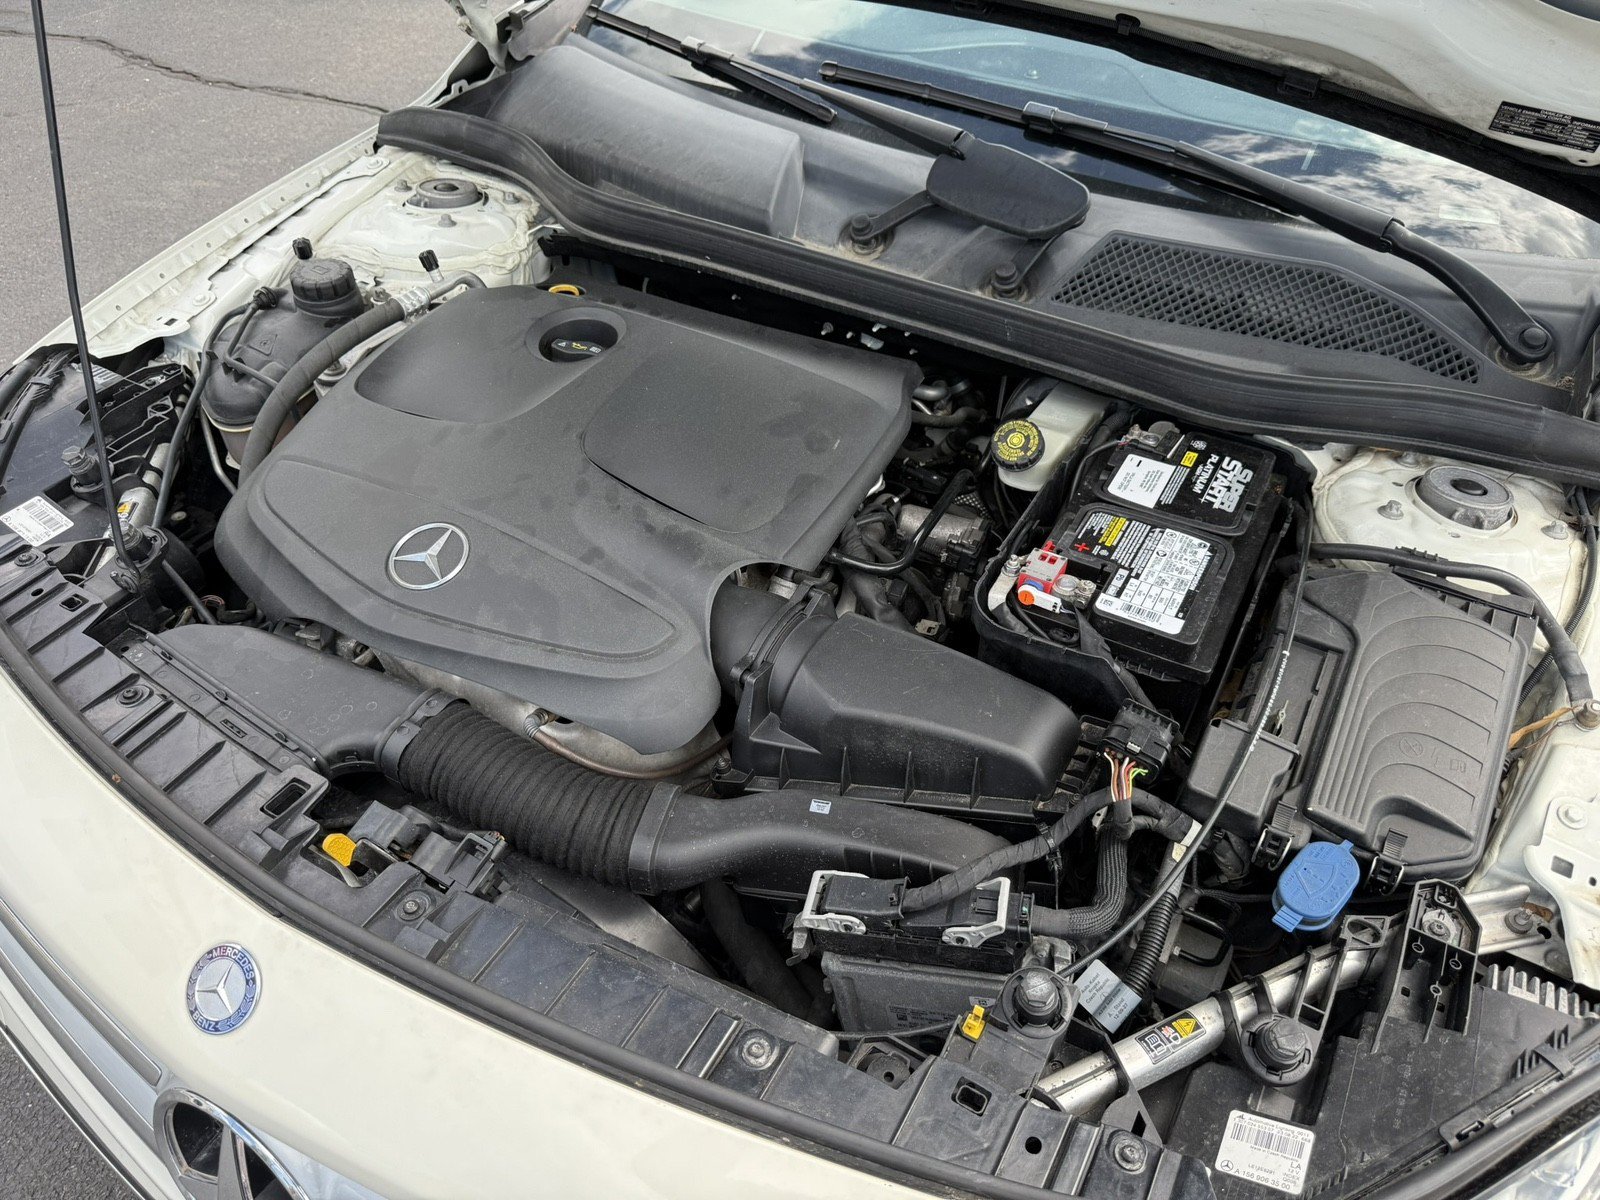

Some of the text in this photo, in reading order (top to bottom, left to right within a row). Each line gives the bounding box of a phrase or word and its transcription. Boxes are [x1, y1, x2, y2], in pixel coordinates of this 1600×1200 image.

[1501, 105, 1521, 113] VEHICLE
[1522, 110, 1547, 118] EMISSION
[1548, 115, 1571, 123] CONTROL
[1192, 453, 1219, 493] PLATINUM
[1207, 457, 1243, 510] START
[1219, 466, 1254, 512] SUPER
[212, 946, 254, 980] MERCEDES
[193, 1011, 216, 1030] BENZ
[1289, 1161, 1302, 1170] LA
[1255, 1174, 1269, 1183] 906
[1280, 1182, 1290, 1190] 00
